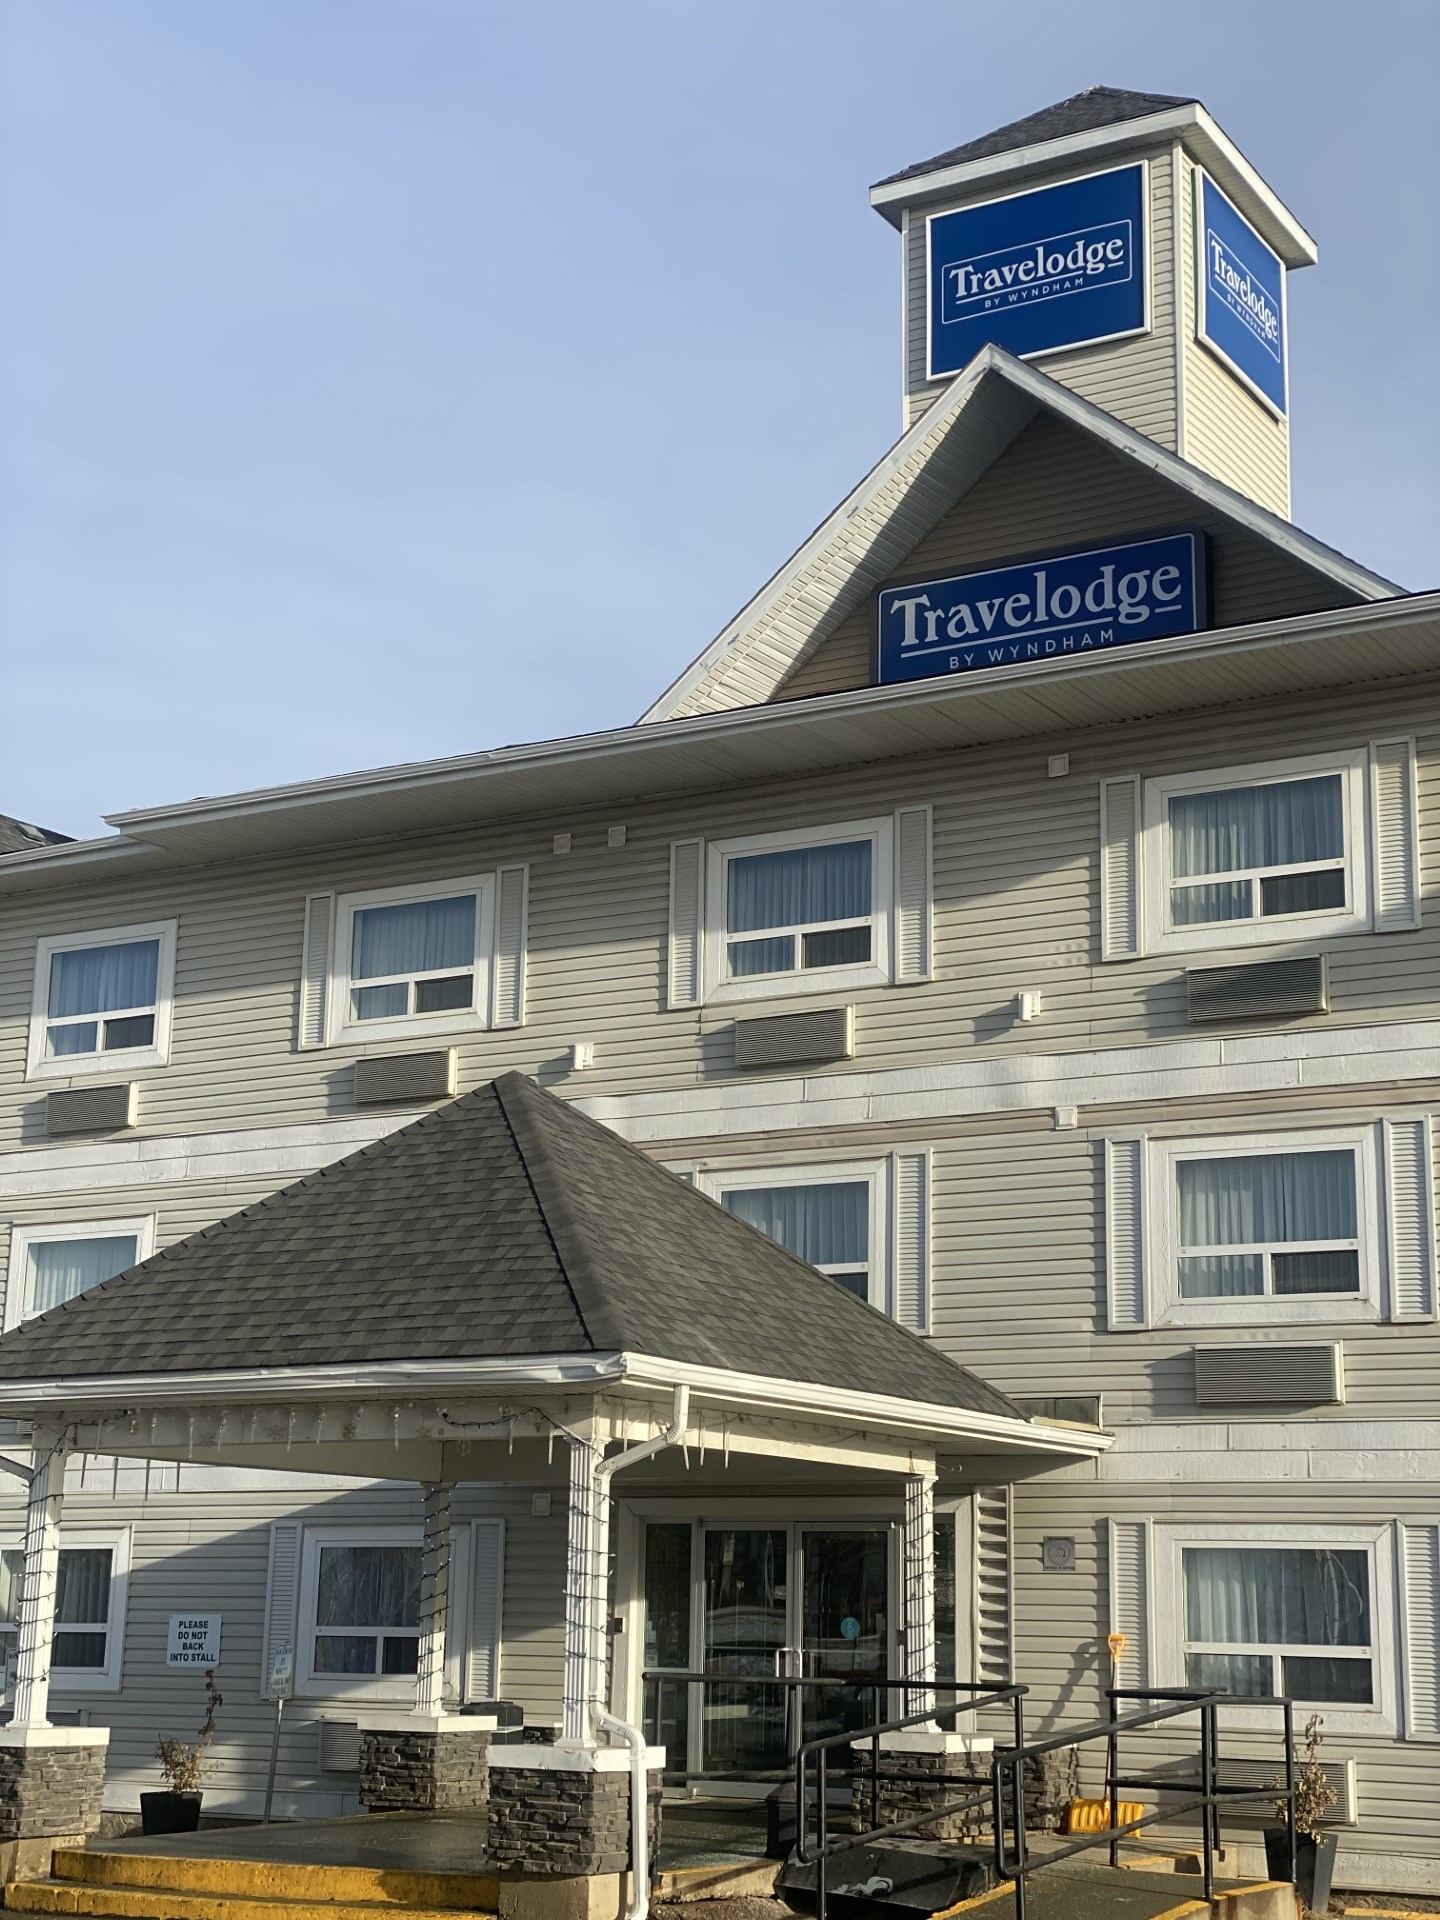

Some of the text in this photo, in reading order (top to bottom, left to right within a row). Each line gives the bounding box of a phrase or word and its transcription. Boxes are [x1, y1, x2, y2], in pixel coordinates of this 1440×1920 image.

[950, 238, 1124, 298] Travelodge
[985, 277, 1084, 308] BY WYNDHAM
[1210, 239, 1278, 339] Travelodge
[890, 564, 1182, 646] Travelodge
[949, 629, 1114, 669] BY WYNDHAM
[178, 1620, 209, 1629] PLEASE
[178, 1631, 208, 1640] DO NOT
[170, 1653, 216, 1661] INTO STALL
[182, 1642, 204, 1650] BACK
